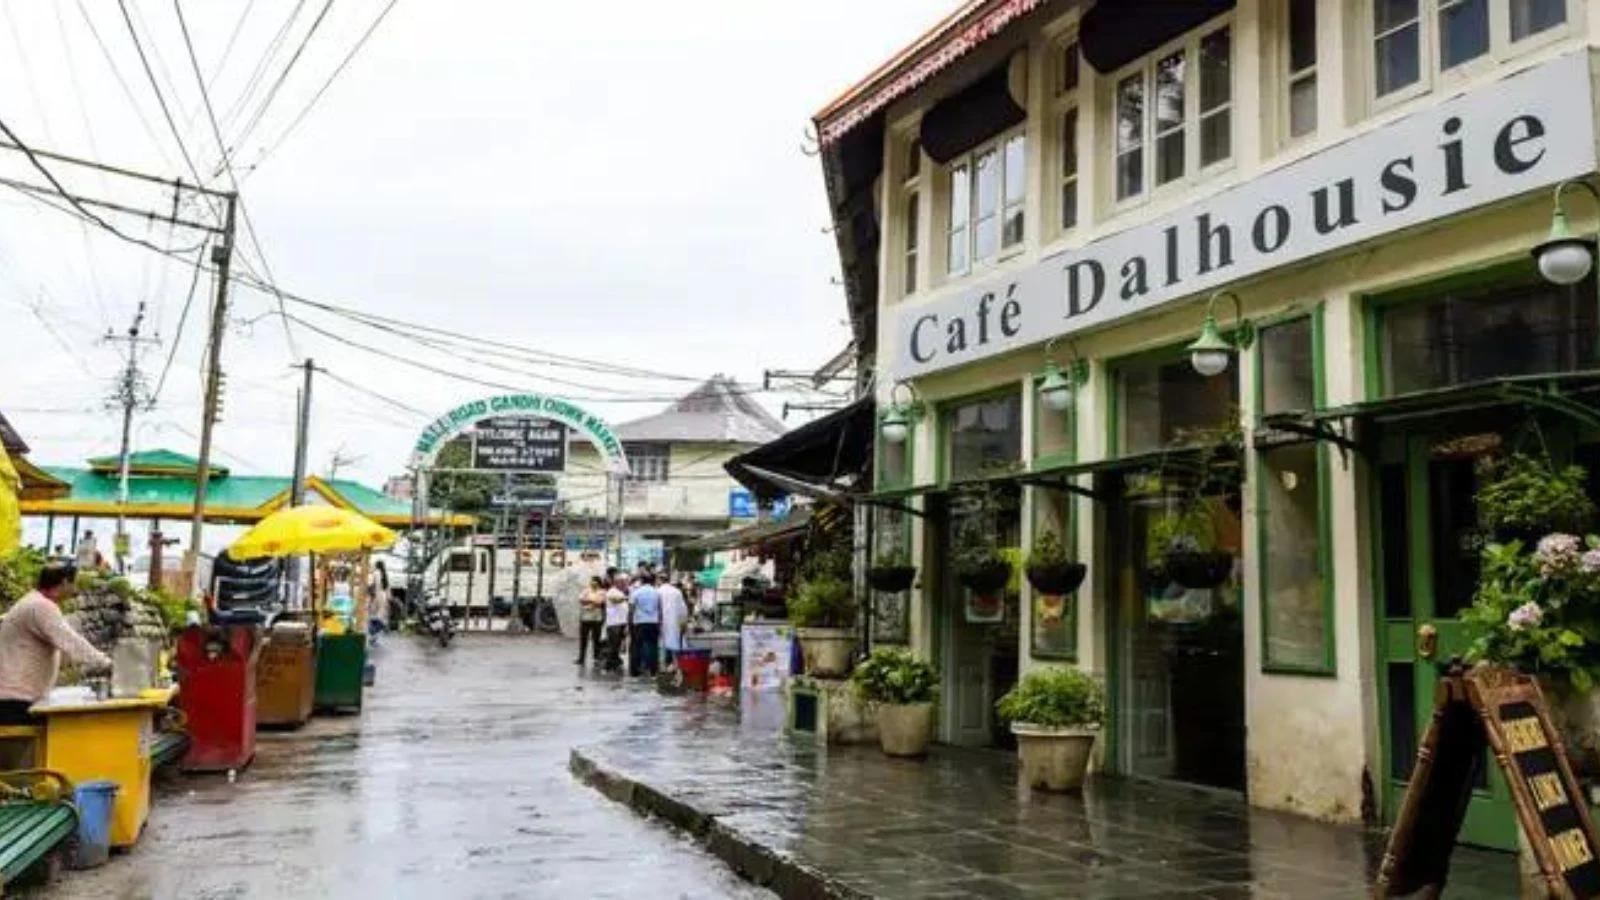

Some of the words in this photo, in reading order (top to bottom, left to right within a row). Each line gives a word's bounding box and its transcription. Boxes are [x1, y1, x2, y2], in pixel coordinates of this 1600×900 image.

[909, 283, 1021, 364] Café
[1065, 114, 1545, 318] Dalhousie
[450, 400, 488, 428] ROAD
[490, 396, 541, 412] GANDHI
